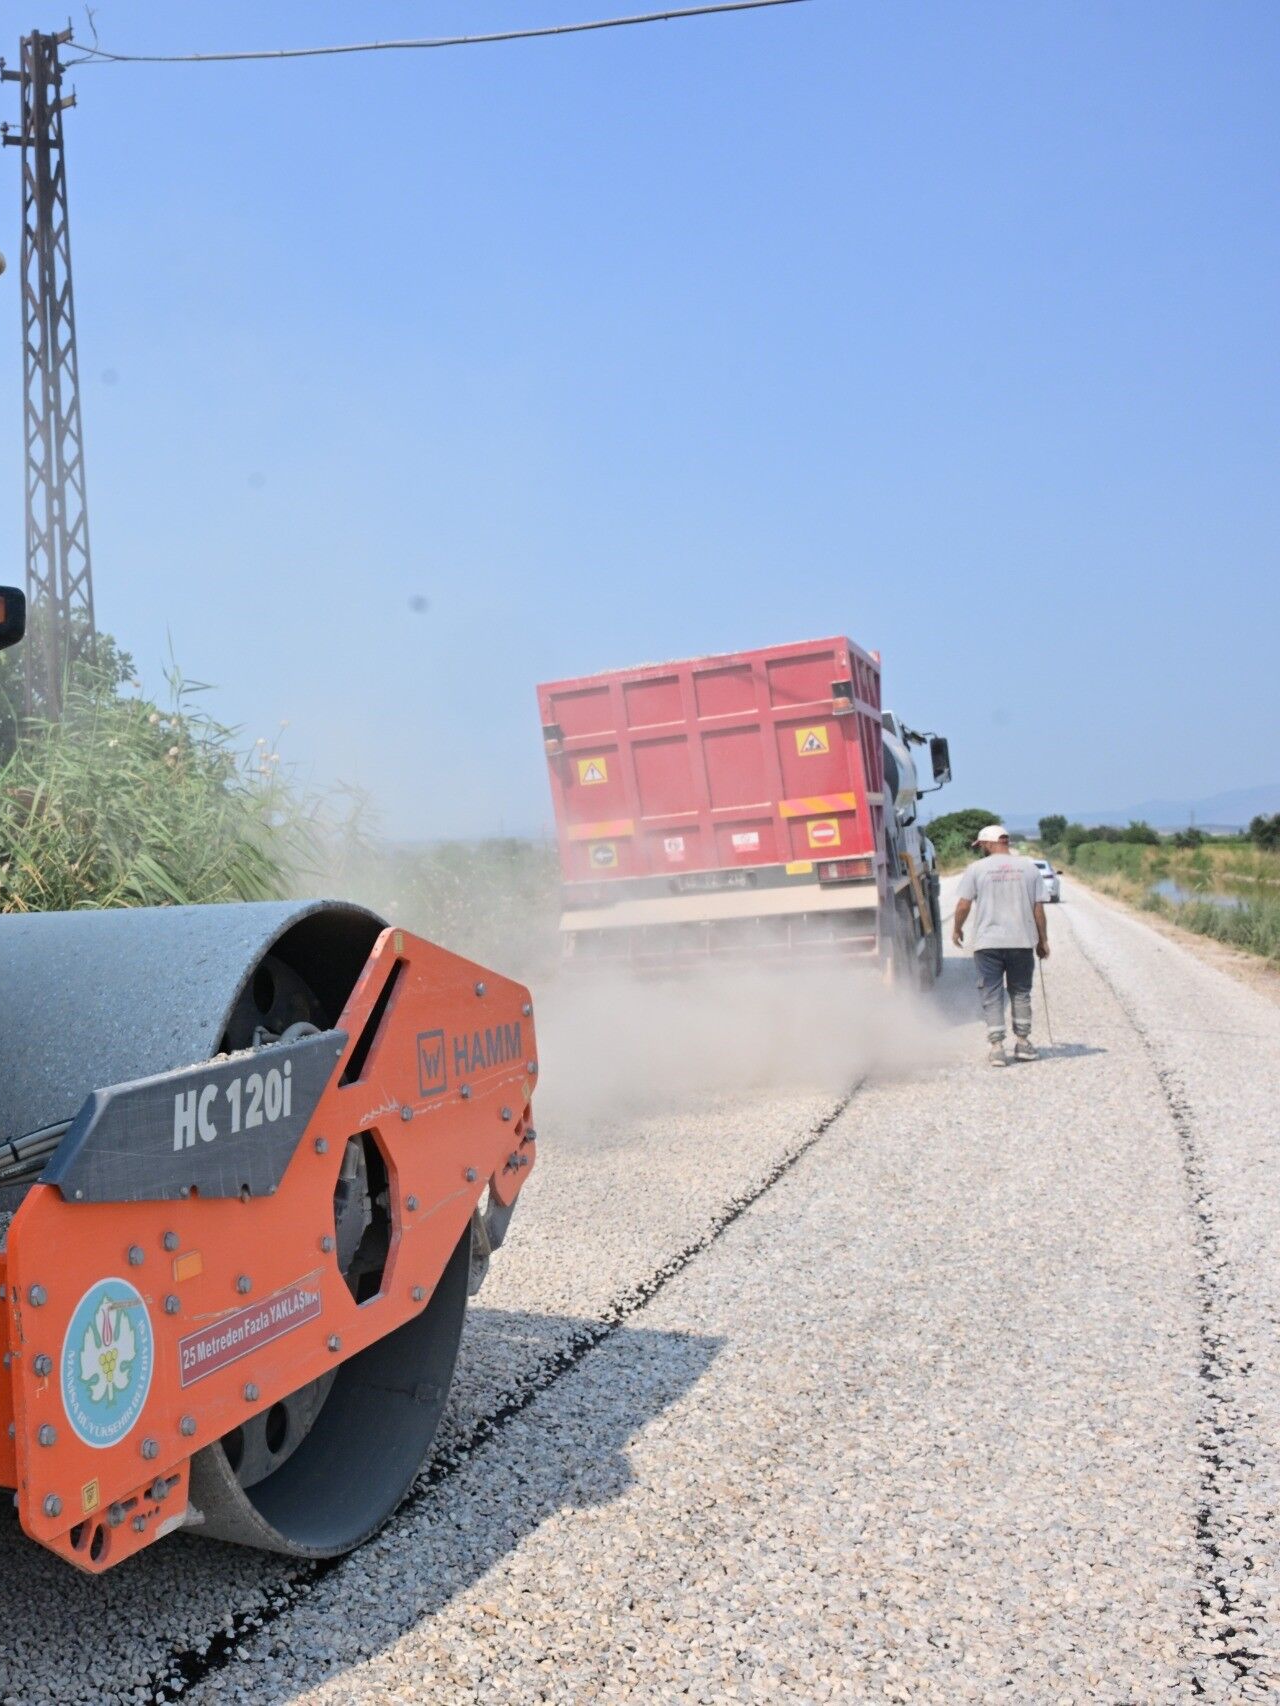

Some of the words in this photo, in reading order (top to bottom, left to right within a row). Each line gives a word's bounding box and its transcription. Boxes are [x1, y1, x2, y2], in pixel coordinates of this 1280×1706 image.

[453, 1021, 522, 1077] HAMM
[173, 1084, 219, 1152] HC
[225, 1059, 292, 1134] 120i
[183, 1345, 196, 1370] 25
[197, 1328, 244, 1362] Metreden
[244, 1312, 270, 1338] Fazla
